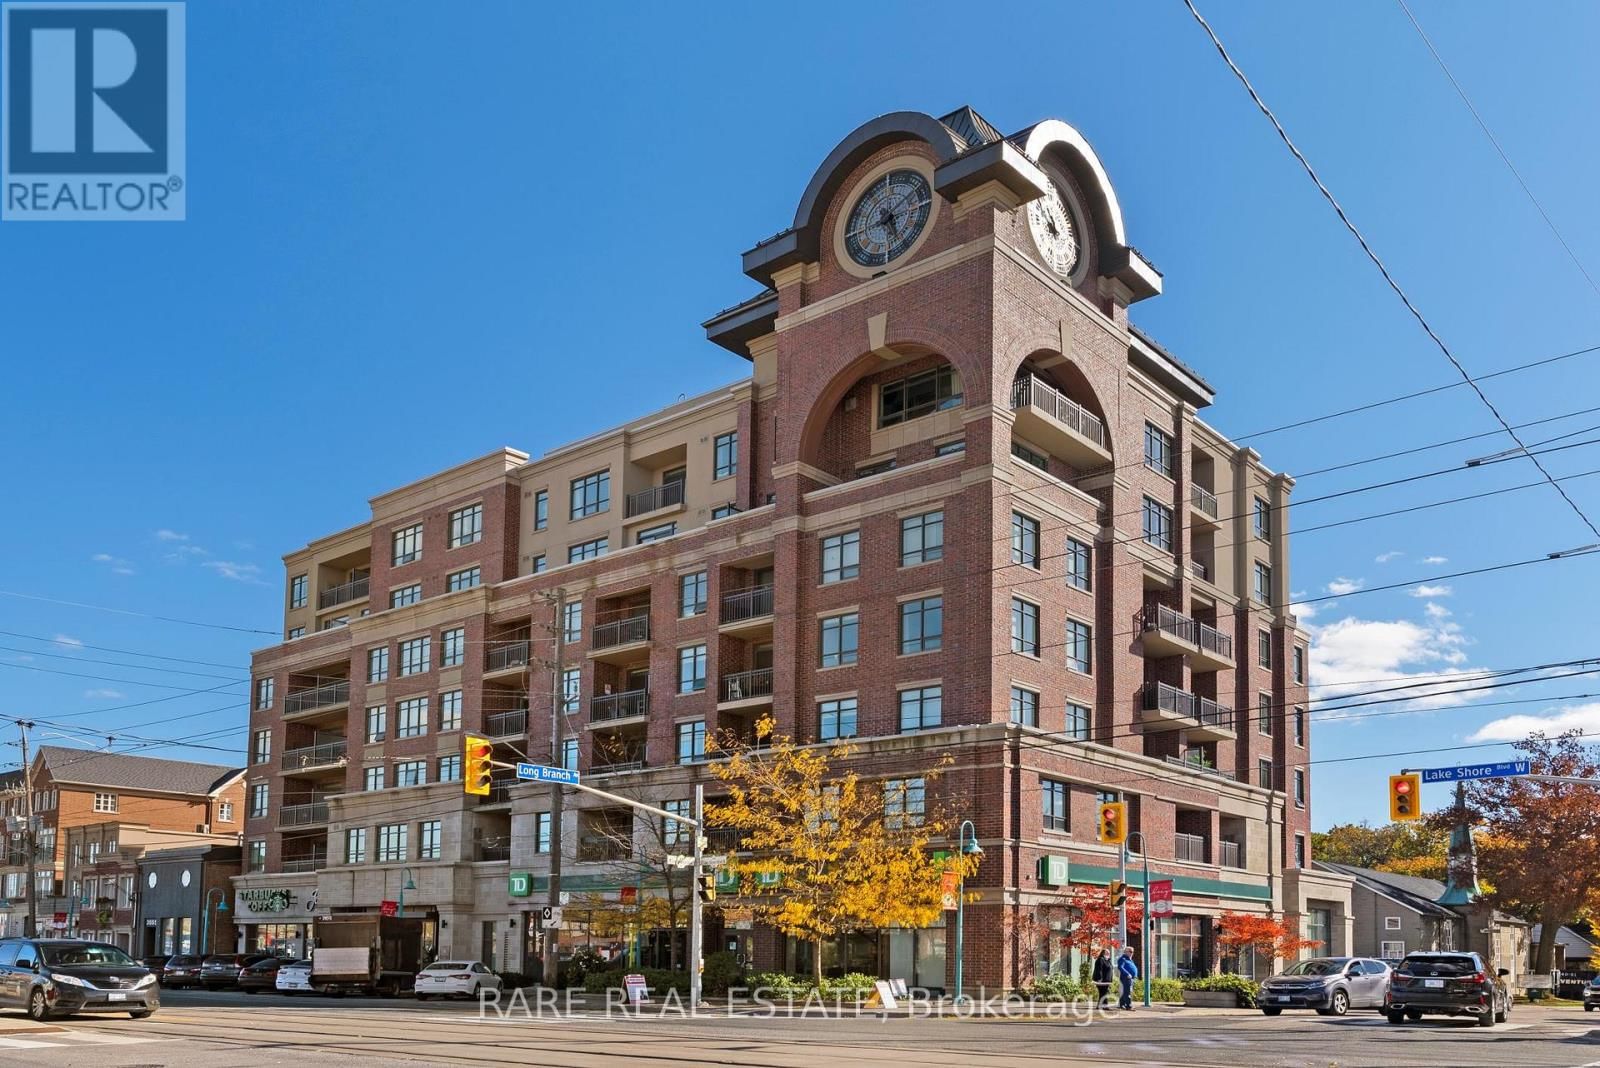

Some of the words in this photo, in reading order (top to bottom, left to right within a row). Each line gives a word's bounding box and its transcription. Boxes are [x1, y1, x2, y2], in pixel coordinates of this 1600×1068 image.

[519, 765, 539, 779] Long
[542, 768, 570, 780] Branch
[1425, 770, 1452, 780] Lake
[1457, 767, 1492, 778] Shore
[1515, 763, 1525, 772] W
[1051, 861, 1065, 880] TD
[511, 877, 526, 892] TD
